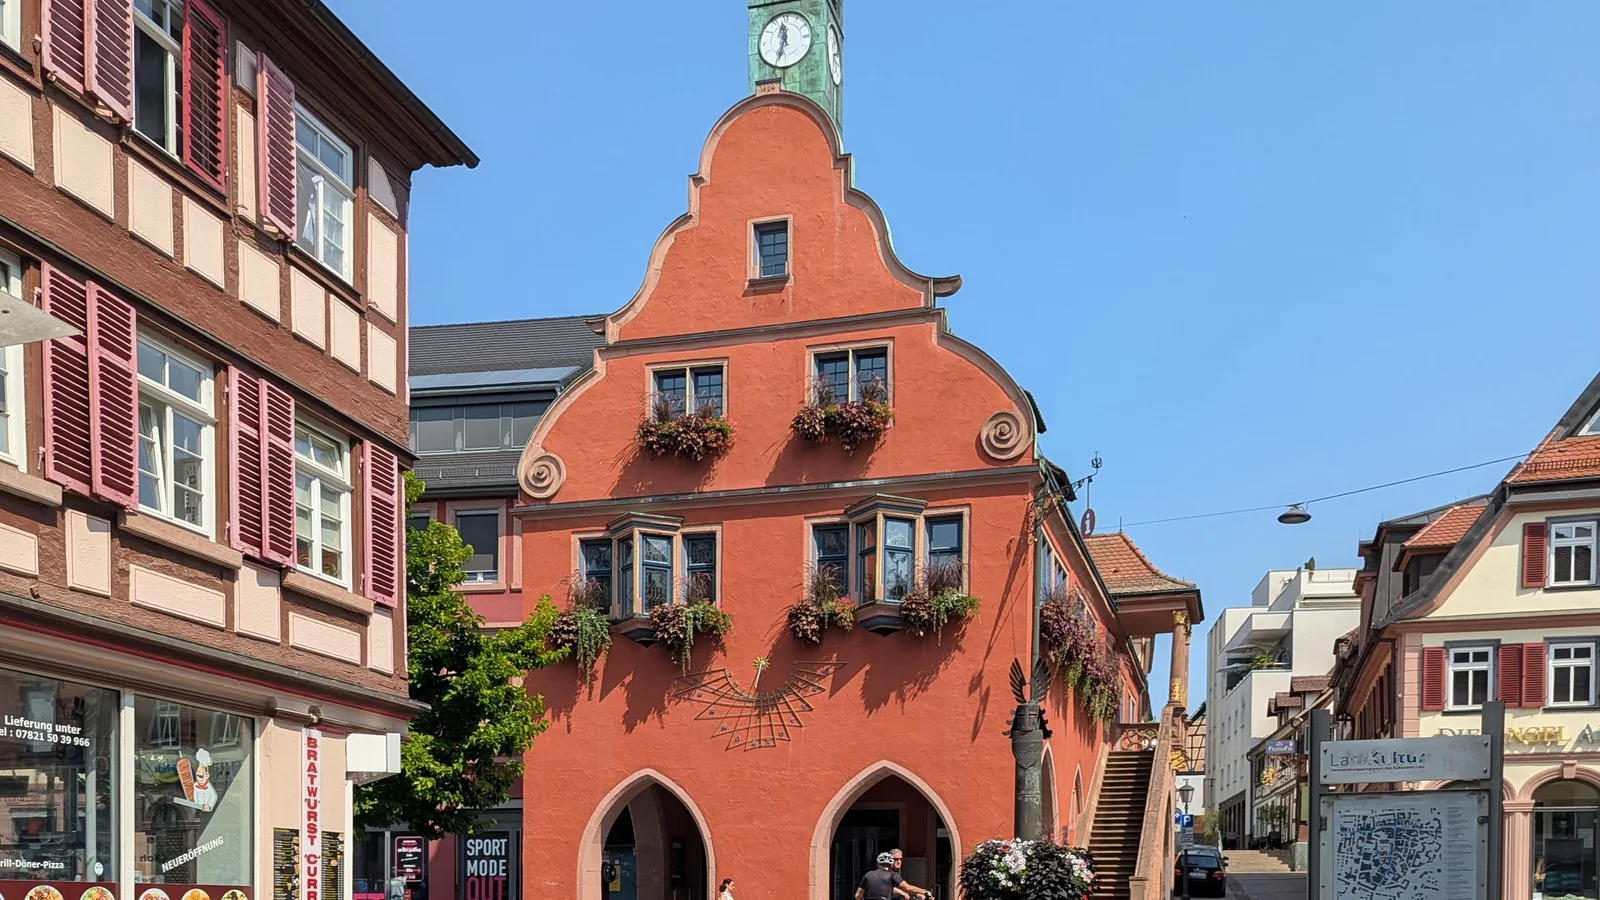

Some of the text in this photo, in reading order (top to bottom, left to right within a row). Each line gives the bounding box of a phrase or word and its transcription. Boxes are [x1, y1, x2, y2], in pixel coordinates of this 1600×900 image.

[4, 715, 81, 735] Lieferung unter
[1506, 725, 1572, 743] NGEL
[15, 728, 45, 742] 07821
[47, 733, 59, 743] 50
[60, 734, 72, 745] 39
[73, 736, 90, 747] 966
[306, 737, 318, 846] BRATWURST
[1184, 815, 1191, 827] P
[161, 835, 224, 873] NEUERÖFFNUNG
[466, 838, 508, 856] SPORT
[0, 858, 65, 869] rill-Döner-Pizza
[466, 859, 507, 877] MODE
[466, 876, 507, 900] OUT
